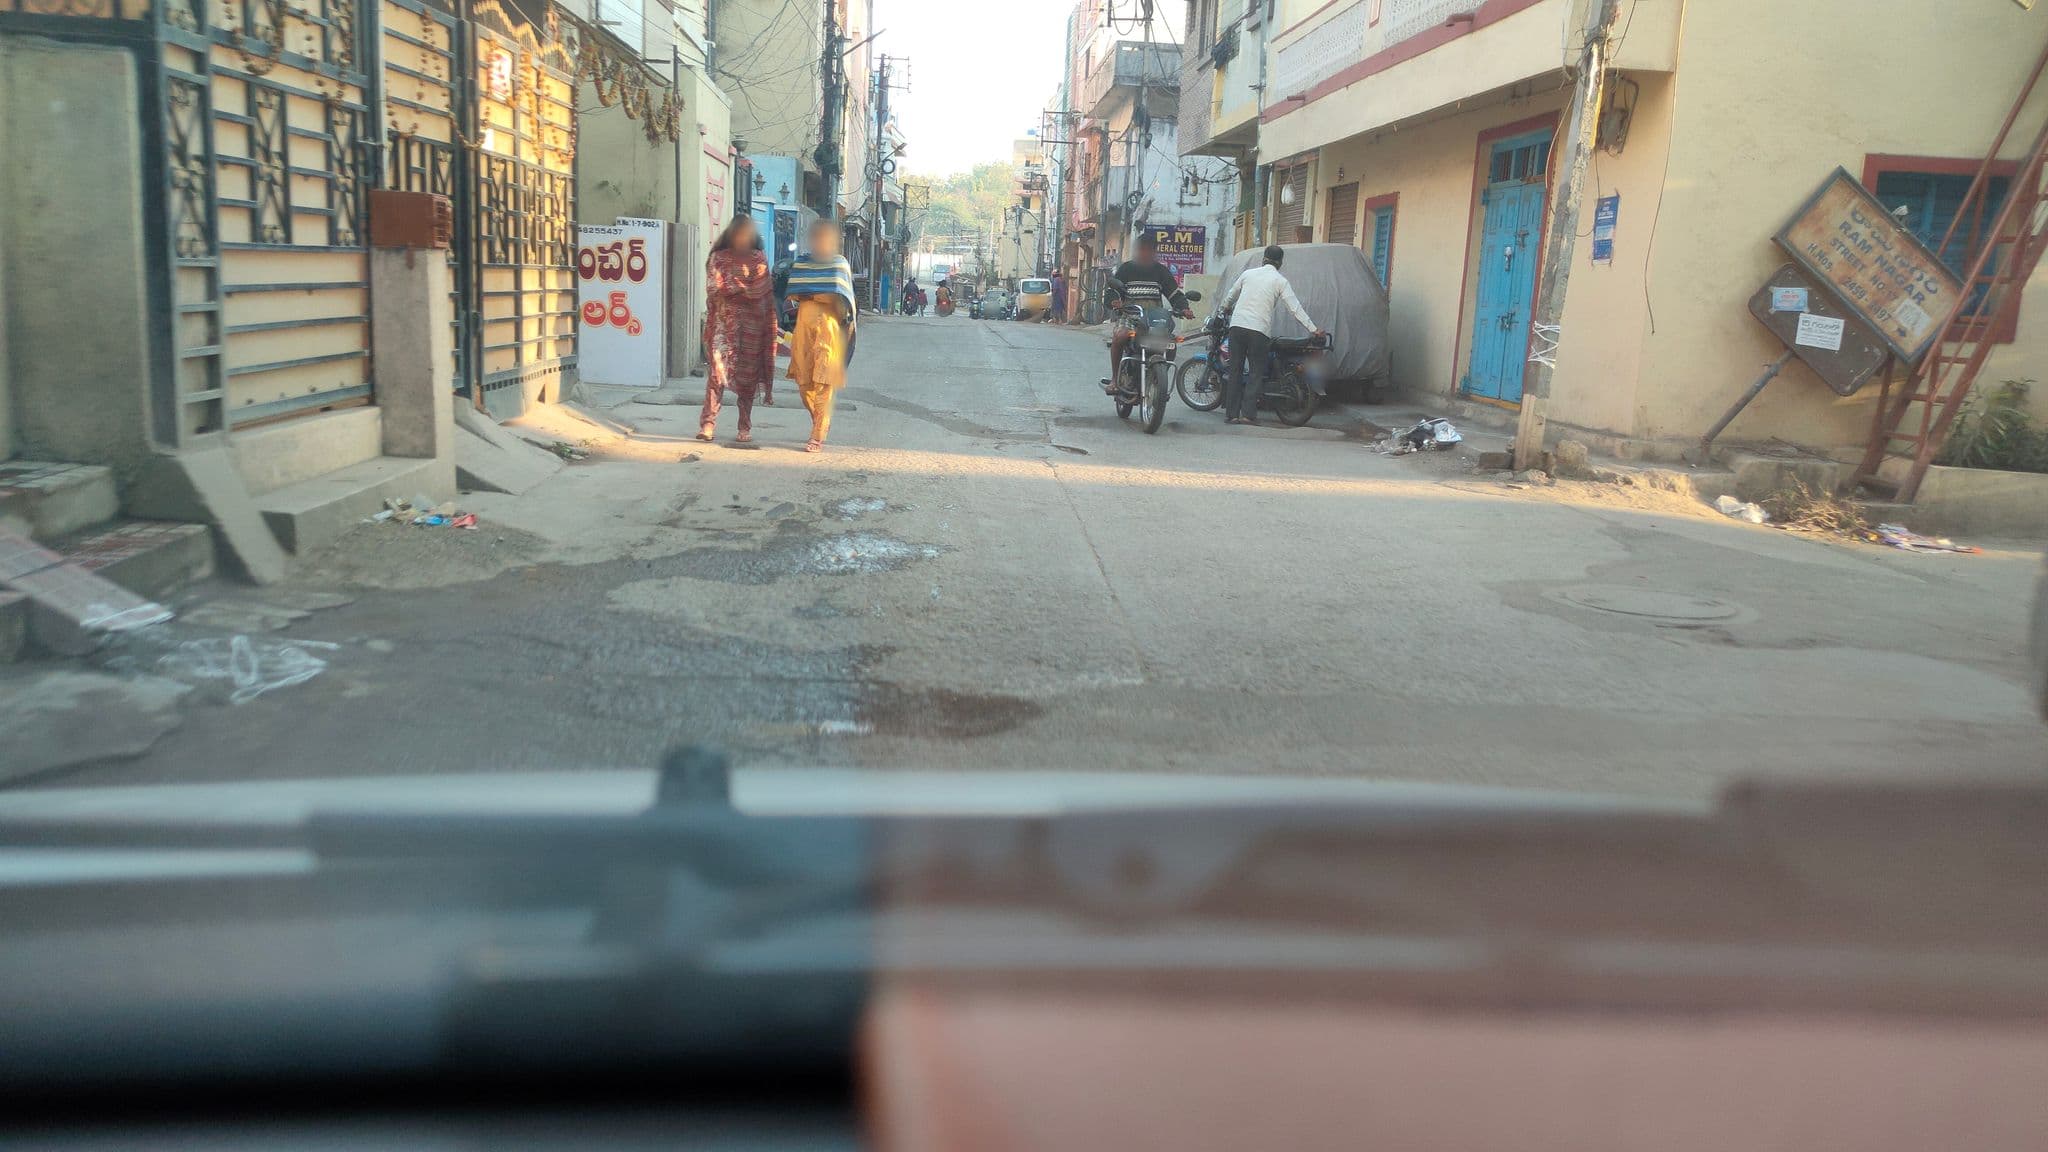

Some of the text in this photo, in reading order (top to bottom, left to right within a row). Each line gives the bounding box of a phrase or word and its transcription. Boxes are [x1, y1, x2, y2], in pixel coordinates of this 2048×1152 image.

[1156, 231, 1192, 243] P.M
[1180, 245, 1203, 253] STORE
[1830, 237, 1866, 273] STREET
[1839, 220, 1873, 255] RAM
[1875, 254, 1925, 306] NAGAR
